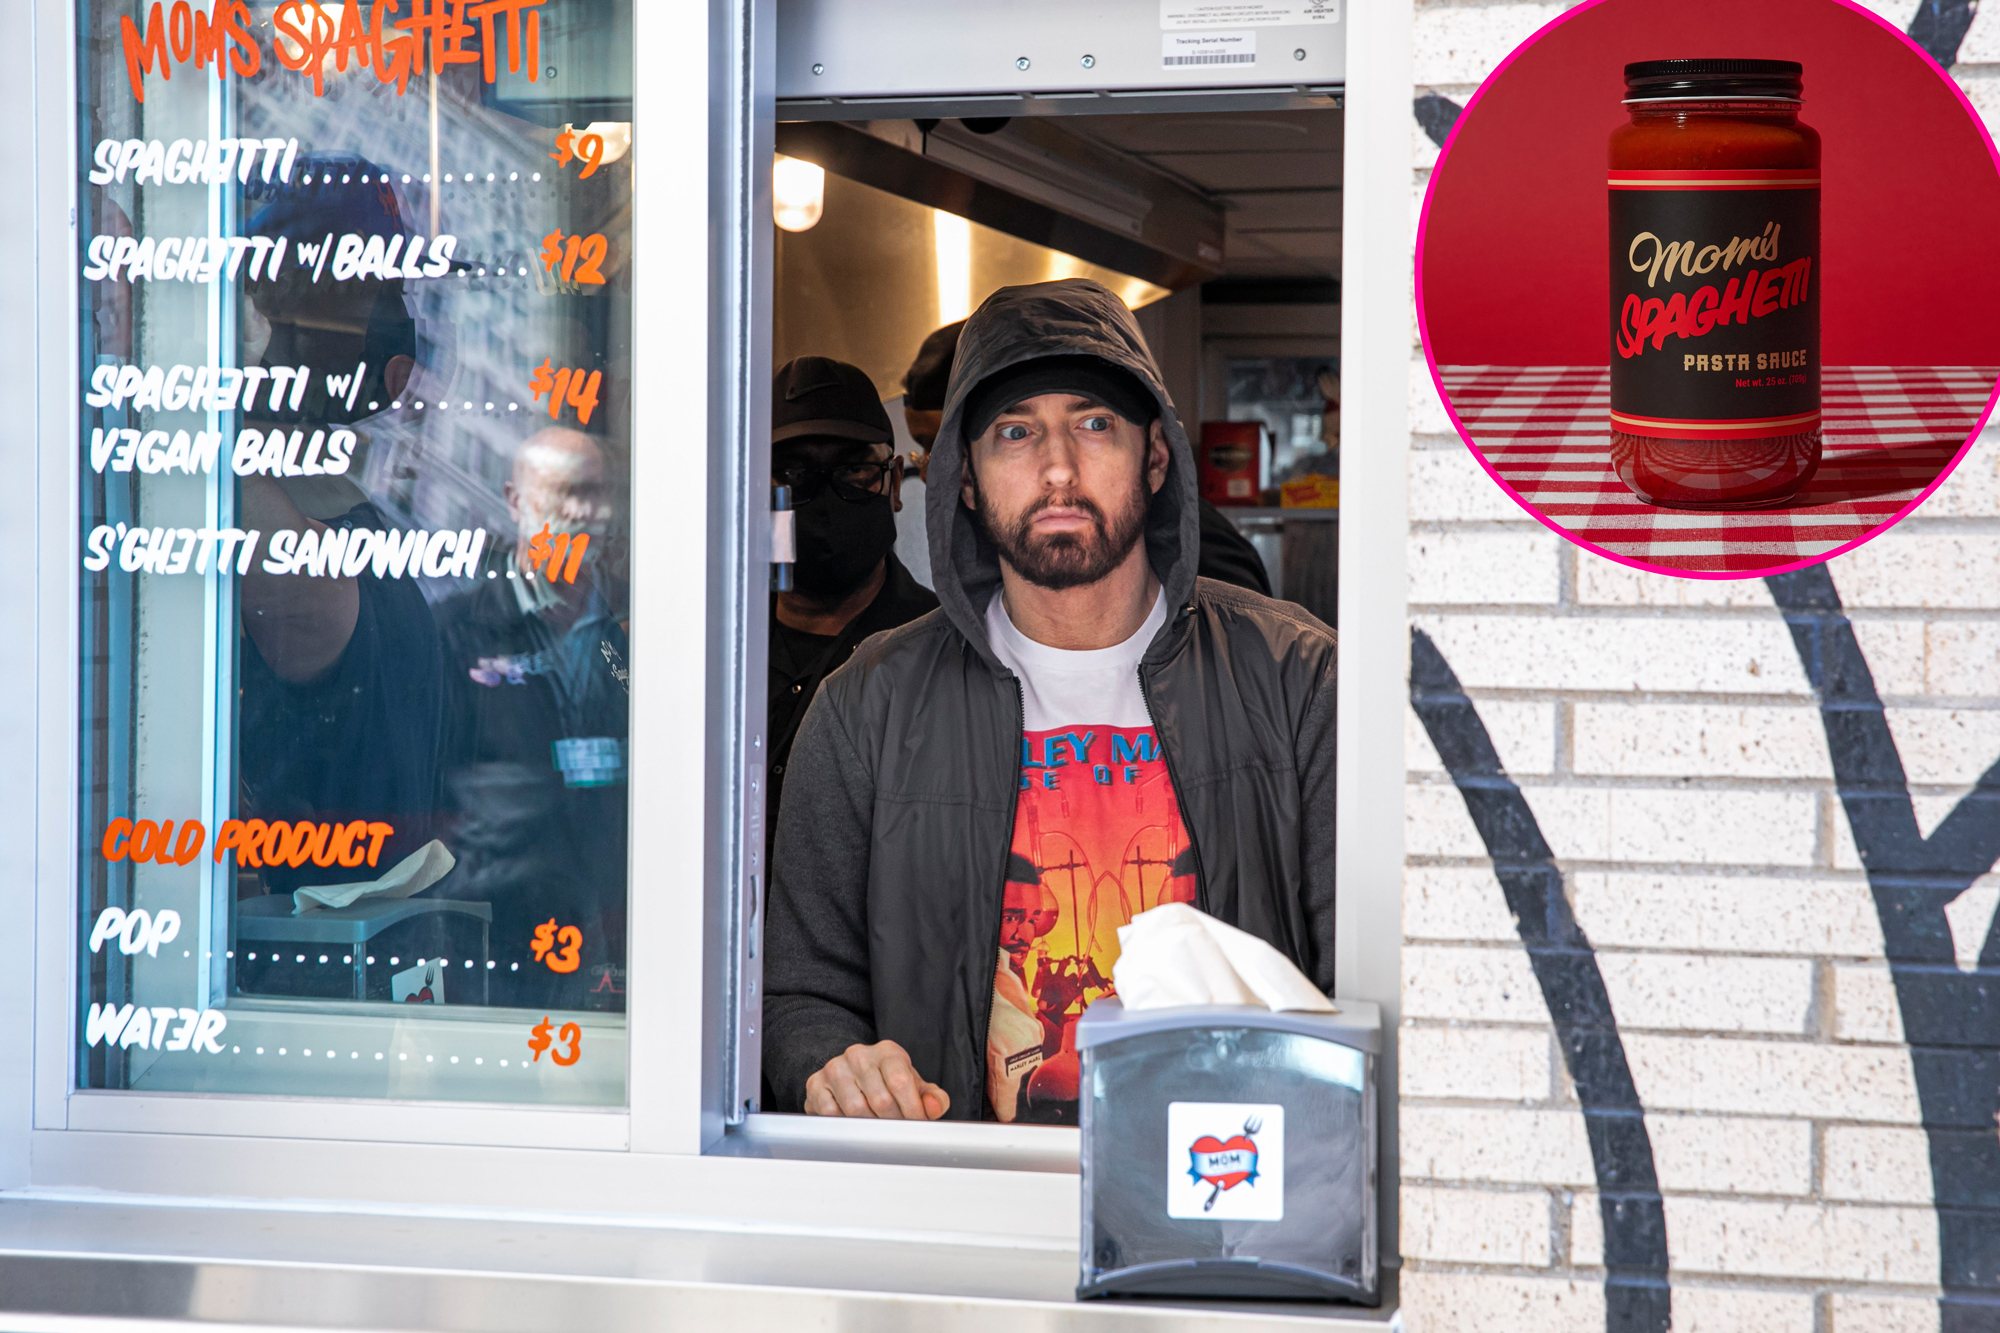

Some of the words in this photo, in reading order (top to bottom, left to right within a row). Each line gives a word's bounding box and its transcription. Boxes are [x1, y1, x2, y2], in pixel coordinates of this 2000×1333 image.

[120, 0, 261, 104] MOMS
[272, 0, 547, 97] SPAGHETTI
[549, 128, 604, 180] $9
[540, 228, 609, 285] $12
[1628, 220, 1782, 288] Mom's
[1615, 255, 1812, 359] SPAGHETTI
[1683, 354, 1751, 372] PASTA
[1756, 349, 1807, 370] SAUCE
[1735, 378, 1751, 388] Net
[1751, 378, 1765, 388] wt.
[1765, 376, 1777, 387] 25
[1776, 377, 1788, 386] oz.
[529, 358, 602, 425] $14
[231, 429, 357, 477] BALLS
[262, 528, 487, 579] SANDWICH
[527, 523, 590, 585] $11
[102, 817, 206, 866] COLD
[213, 818, 394, 869] PRODUCT
[89, 906, 182, 958] POP
[530, 918, 583, 973] $3
[527, 1015, 582, 1067] $3
[1208, 1153, 1241, 1169] MOM
